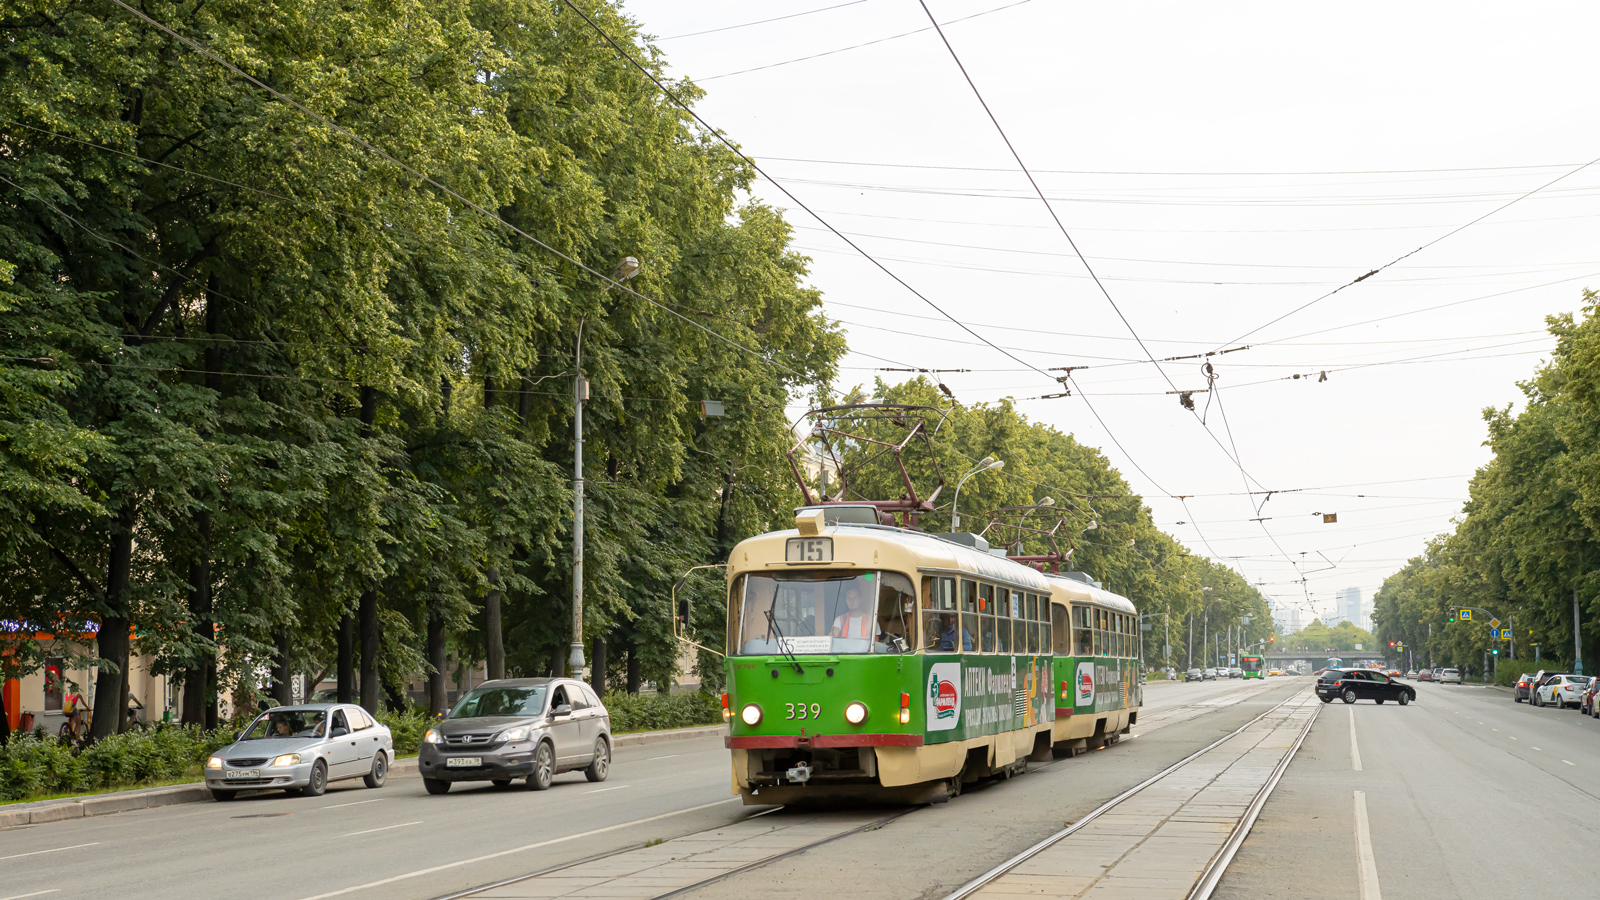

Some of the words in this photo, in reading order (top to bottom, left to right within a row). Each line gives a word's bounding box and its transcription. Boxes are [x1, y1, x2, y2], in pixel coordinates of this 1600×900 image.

[800, 541, 823, 562] 15
[965, 667, 986, 697] АПТЕКИ
[785, 703, 822, 720] 339
